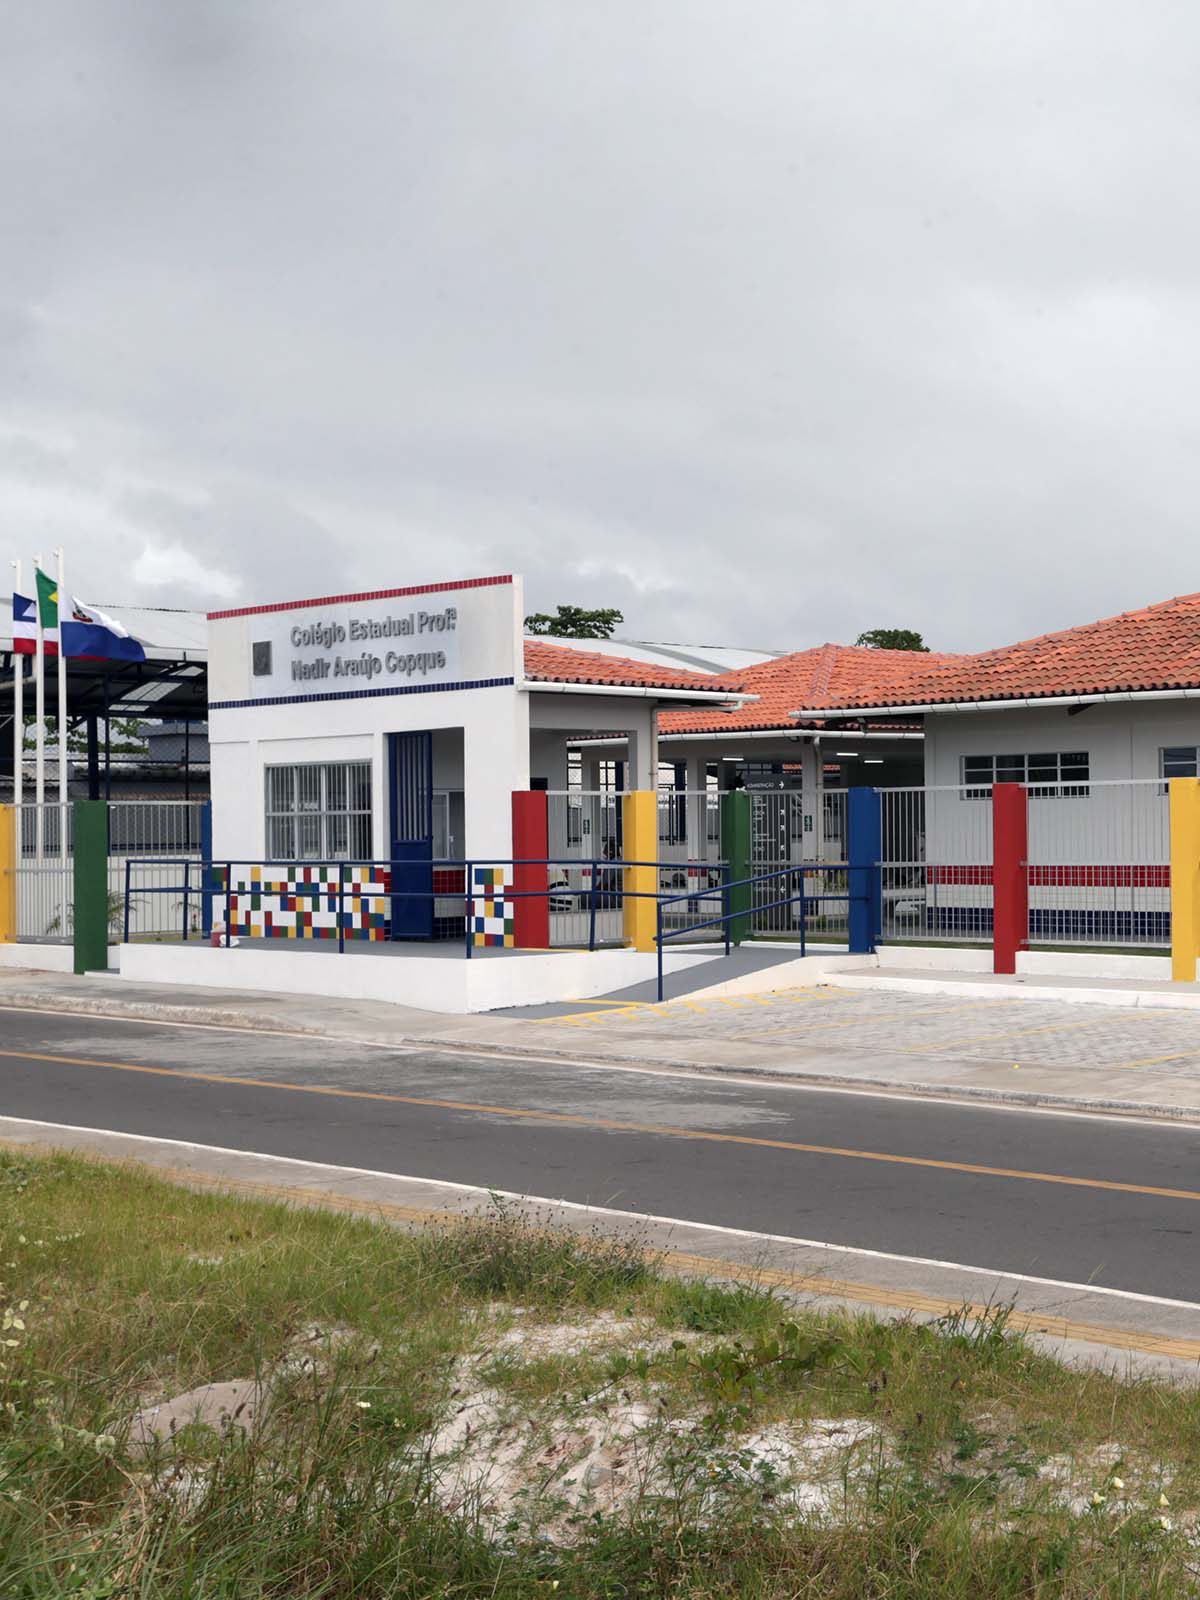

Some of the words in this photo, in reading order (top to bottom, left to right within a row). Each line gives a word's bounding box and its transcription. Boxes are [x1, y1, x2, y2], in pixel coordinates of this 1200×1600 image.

[291, 622, 346, 649] Colégio
[349, 613, 415, 641] Estadual
[291, 658, 330, 681] Nadir
[333, 652, 382, 680] Araújo
[385, 650, 446, 677] Copque
